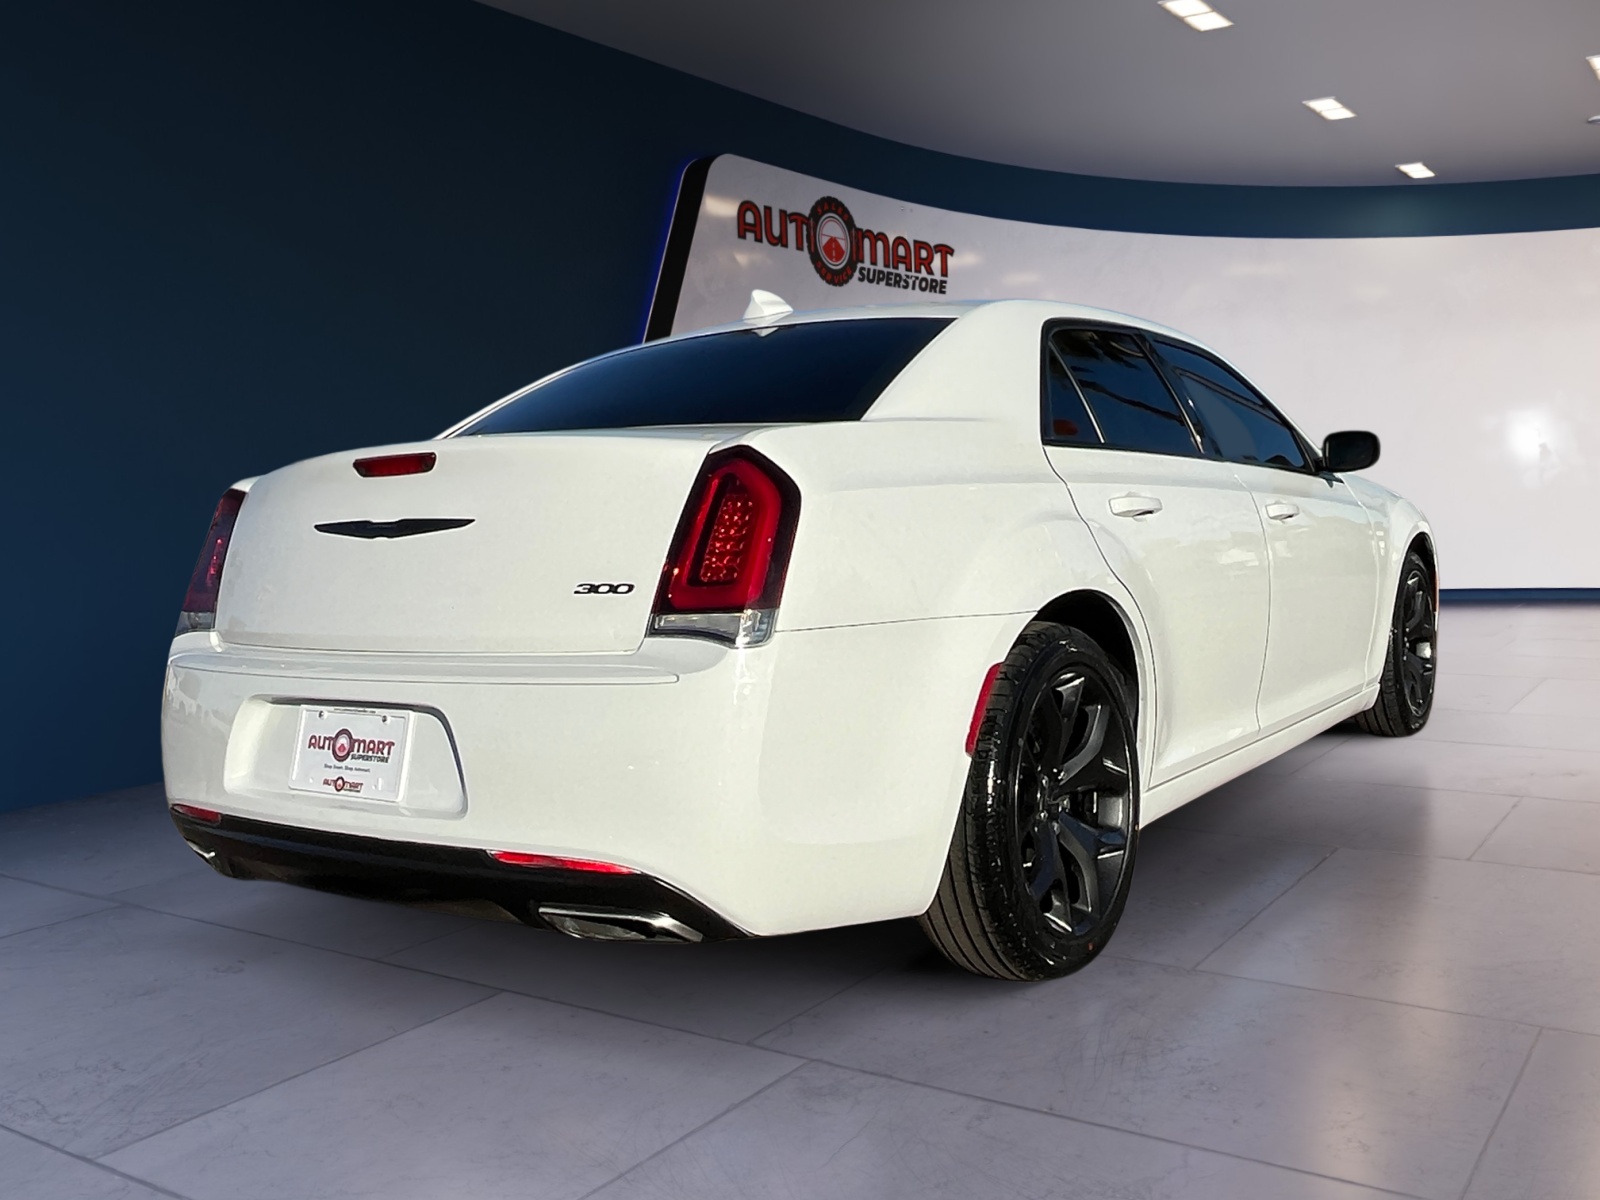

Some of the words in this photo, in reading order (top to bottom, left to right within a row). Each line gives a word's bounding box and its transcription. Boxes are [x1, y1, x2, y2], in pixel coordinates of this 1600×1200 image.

[858, 266, 948, 294] SUPERSTORE
[573, 583, 635, 594] 300
[350, 753, 390, 763] SUPERSTORE
